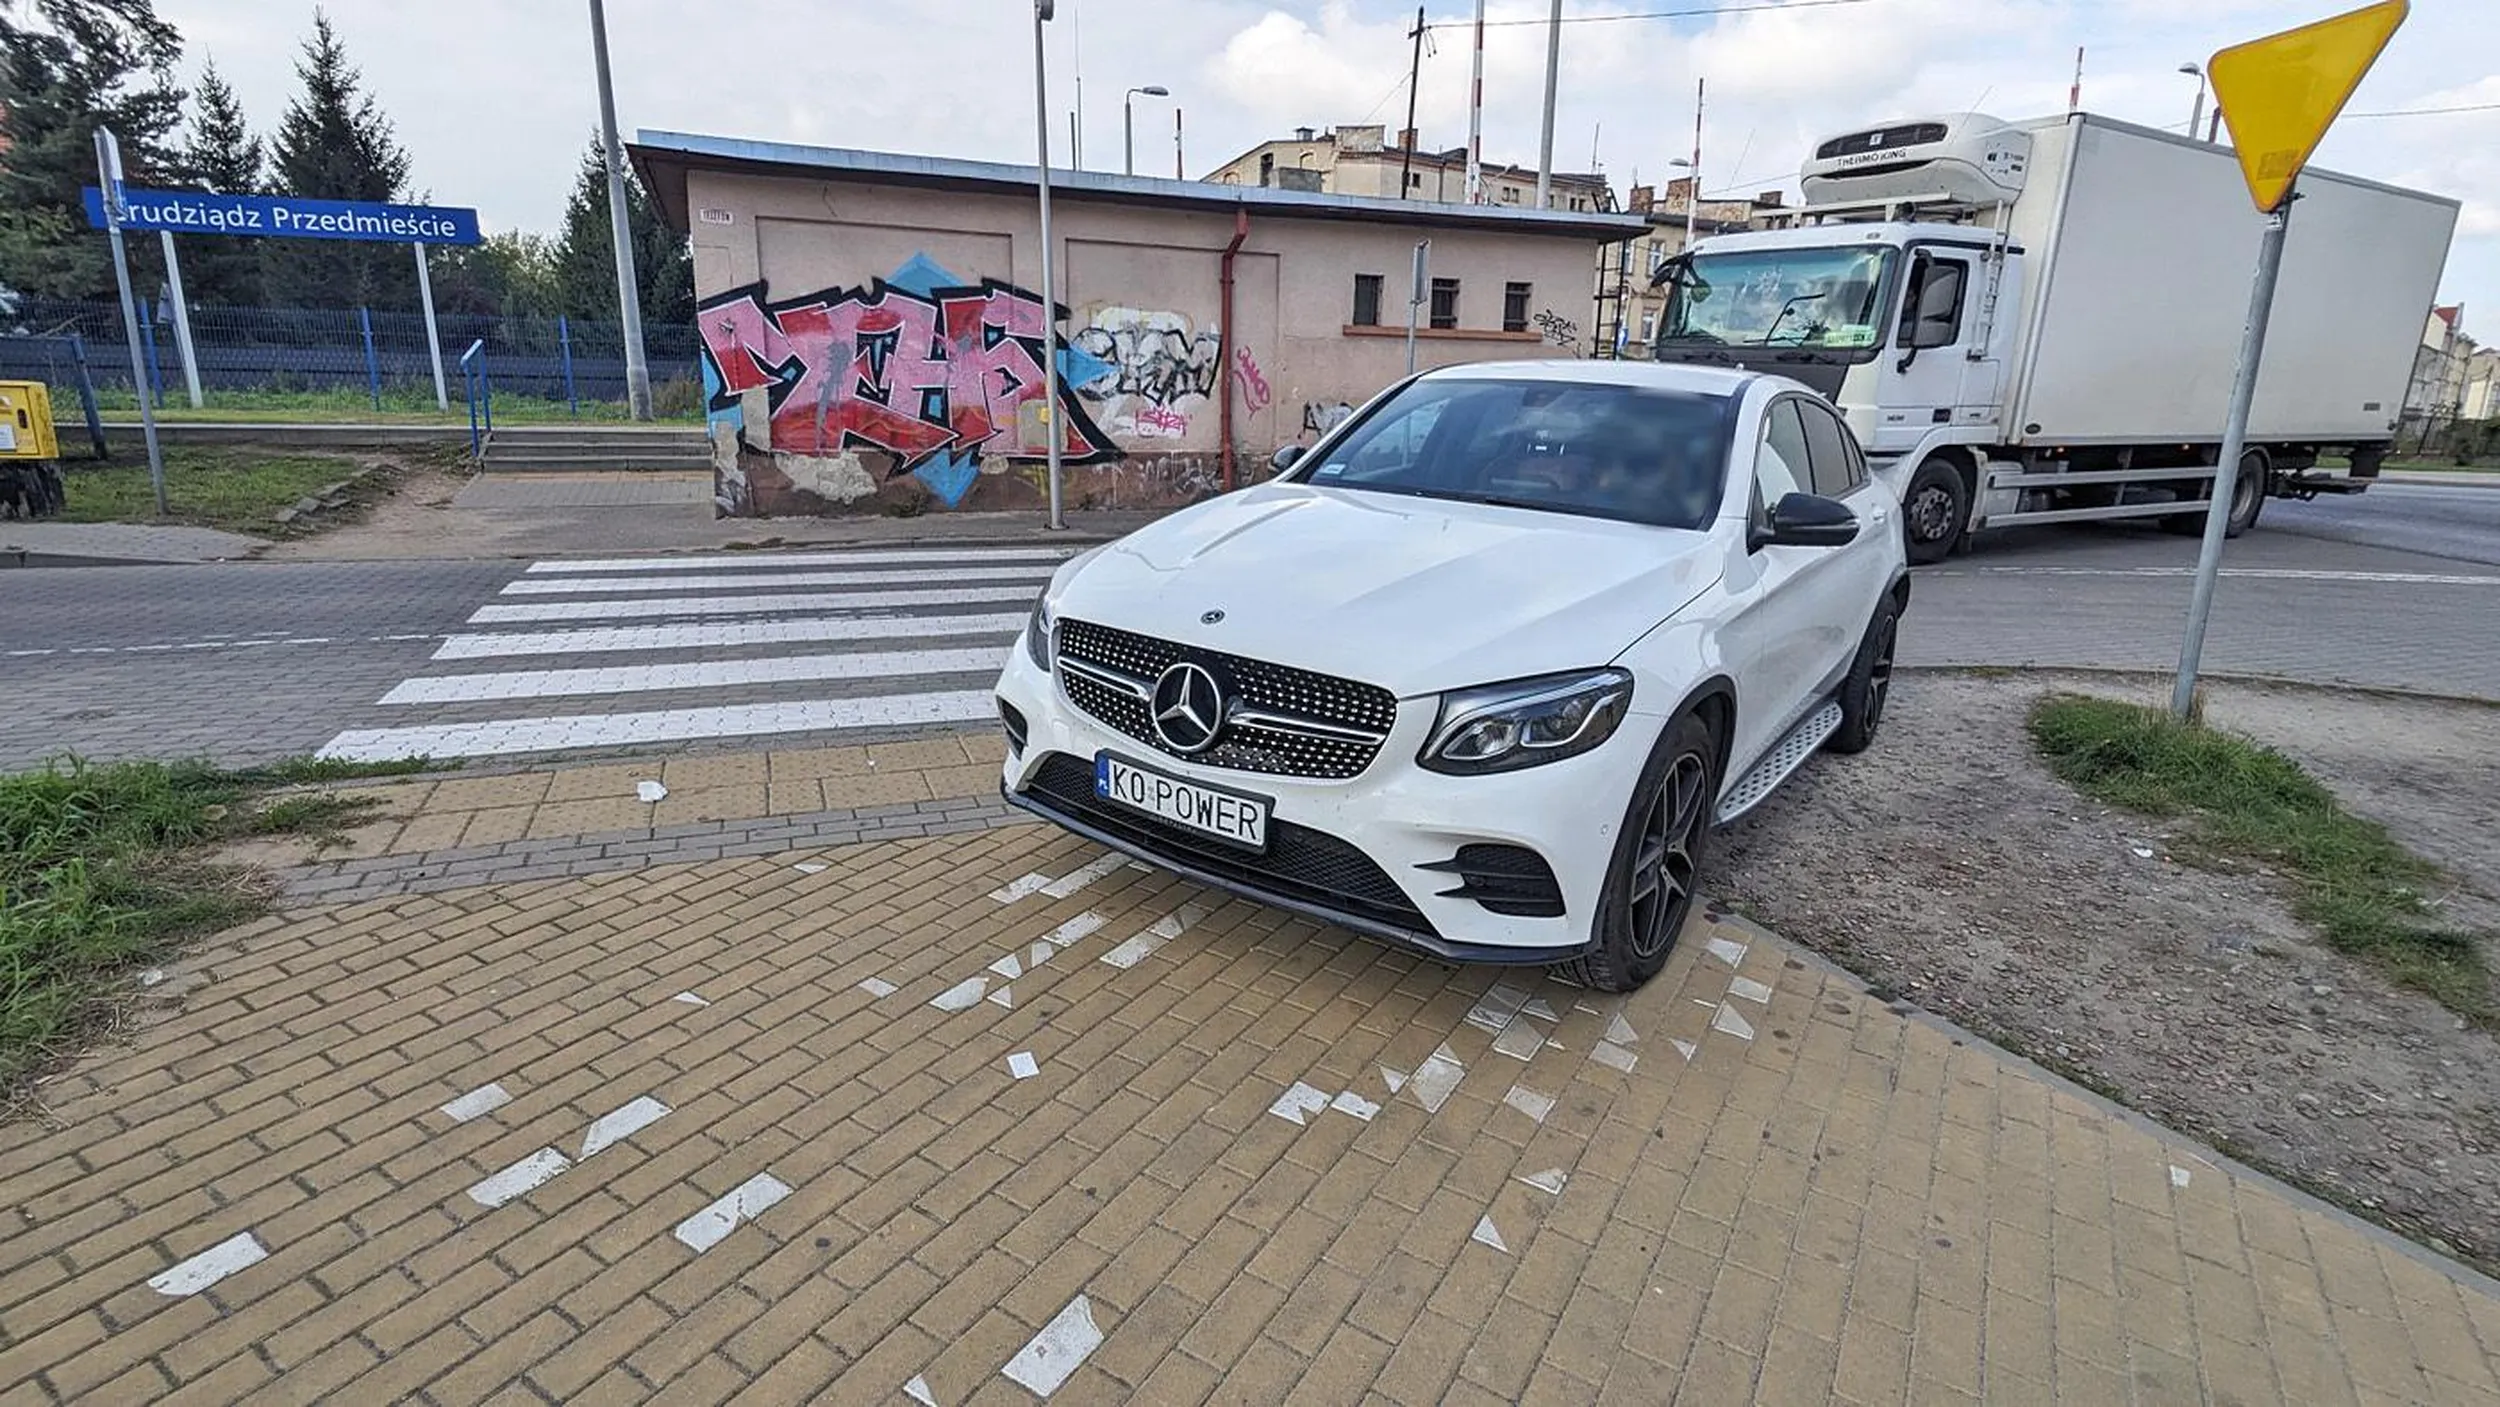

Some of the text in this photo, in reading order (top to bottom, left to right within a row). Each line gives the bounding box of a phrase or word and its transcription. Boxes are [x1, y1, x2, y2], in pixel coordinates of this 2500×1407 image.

[1837, 148, 1907, 167] THERMO KING
[272, 206, 456, 237] Przedmieście
[1156, 779, 1259, 840] POWER
